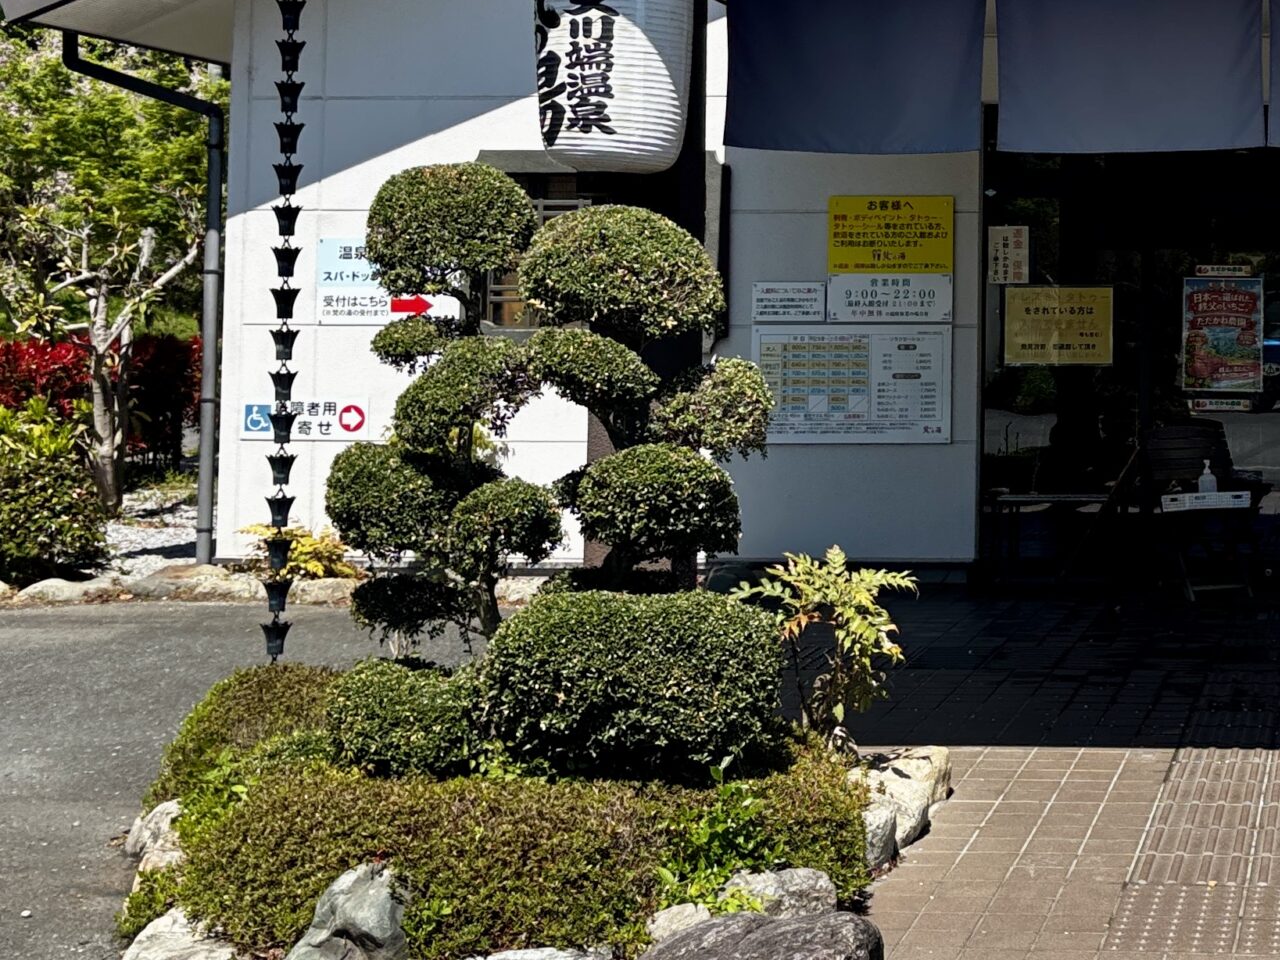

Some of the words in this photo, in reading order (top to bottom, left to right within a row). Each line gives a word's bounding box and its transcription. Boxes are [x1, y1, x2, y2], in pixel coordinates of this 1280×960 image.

[867, 200, 914, 211] お客様へ
[870, 278, 911, 287] 営業時間
[323, 295, 388, 307] 受付はこちら
[1024, 306, 1094, 315] をされている方は
